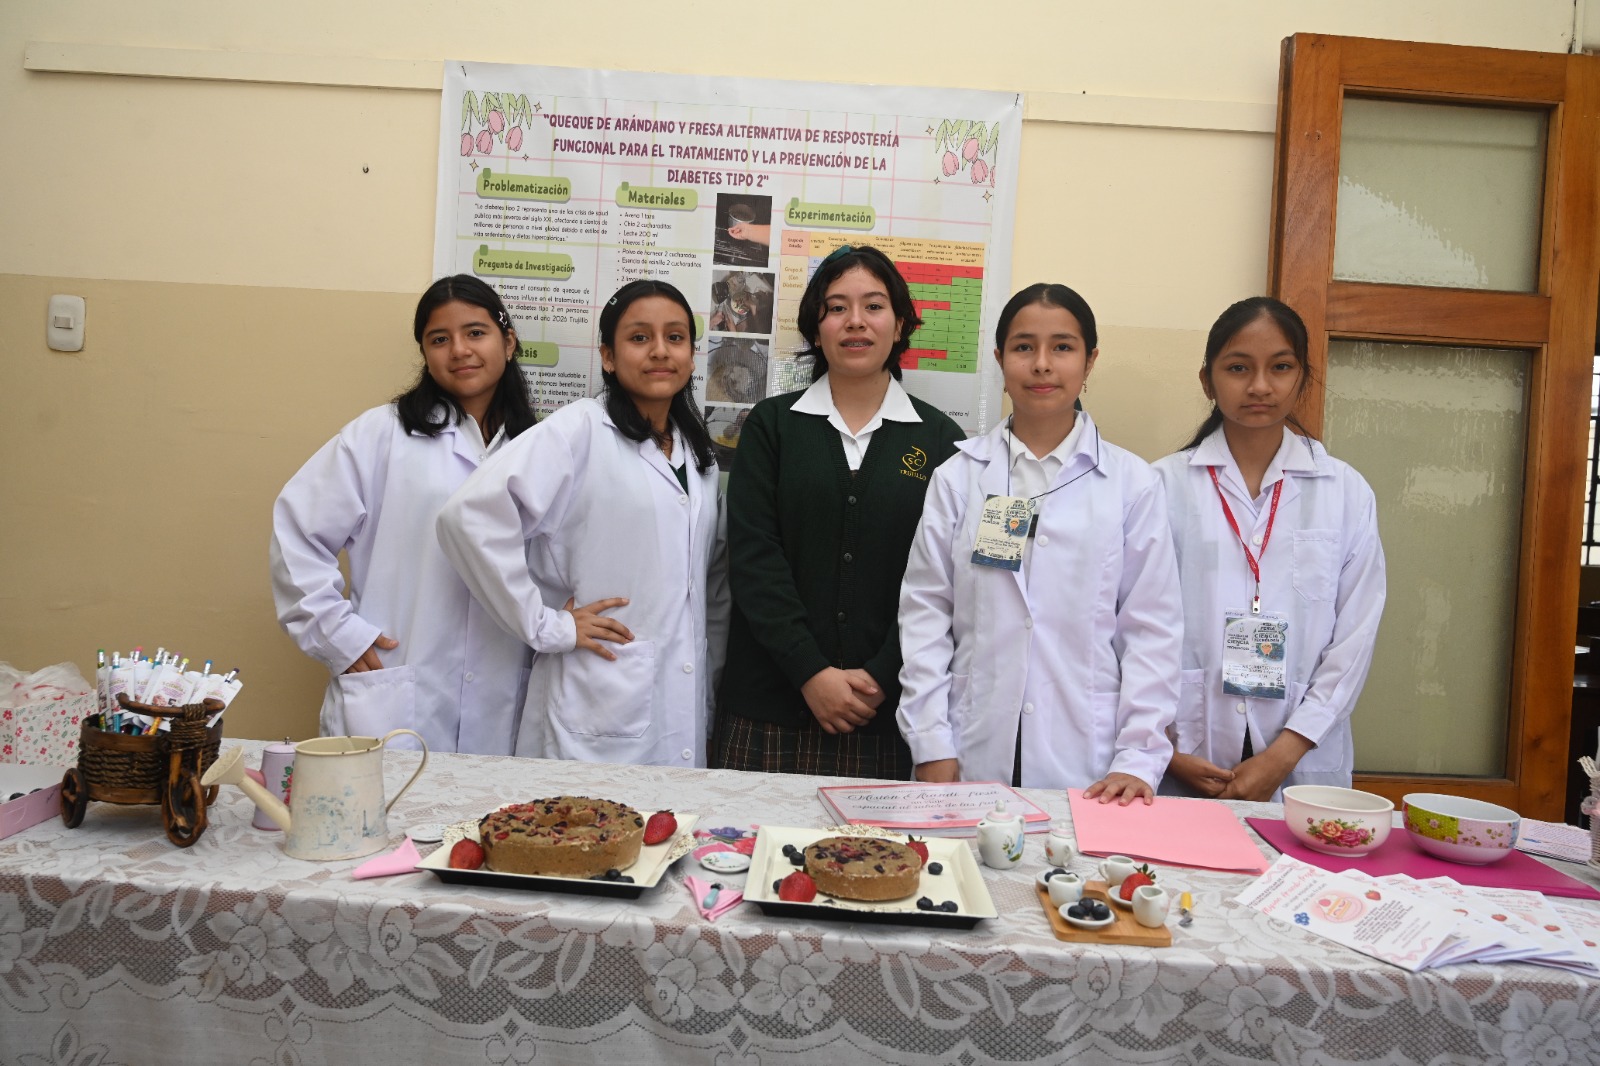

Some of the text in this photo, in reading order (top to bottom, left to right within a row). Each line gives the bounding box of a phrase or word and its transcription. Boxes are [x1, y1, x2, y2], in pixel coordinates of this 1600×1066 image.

[544, 113, 900, 148] "QUEQUE DE ARÁNDANO Y FRESA ALTERNATIVA DE RESPOSTERÍA
[553, 138, 886, 171] FUNCIONAL PARA EL TRATAMIENTO Y LA PREVENCIÓN DE LA
[667, 169, 769, 188] DIABETES TIPO 2"
[484, 180, 568, 196] Problematización
[628, 190, 686, 206] Materiales
[788, 207, 872, 224] Experimentación
[478, 258, 575, 274] Pregunta de Investigación
